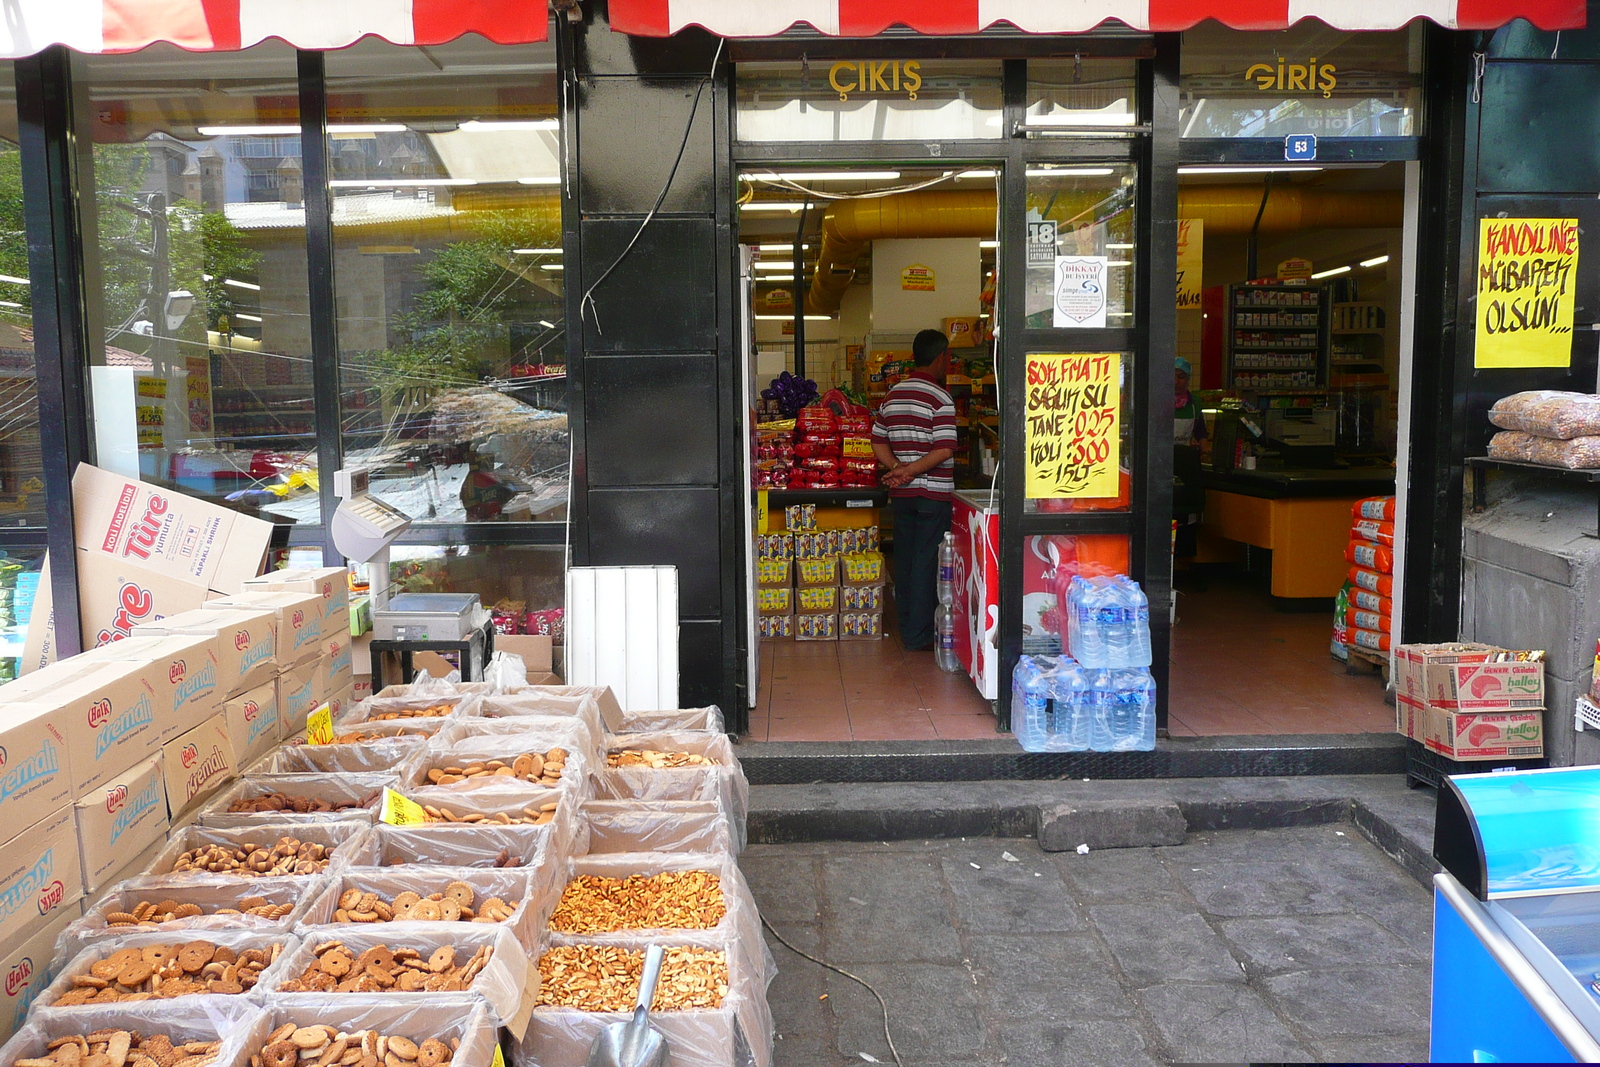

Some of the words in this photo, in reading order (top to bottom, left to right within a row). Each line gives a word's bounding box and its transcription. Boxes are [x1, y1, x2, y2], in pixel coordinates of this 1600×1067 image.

[829, 60, 922, 101] ÇIKIŞ
[1245, 57, 1337, 98] GİRİŞ
[1294, 141, 1307, 153] 53
[1029, 224, 1054, 243] 18
[1480, 257, 1572, 295] MÜBAREK
[1081, 384, 1108, 409] SU
[106, 526, 119, 550] KOLİ
[113, 487, 134, 530] İADELİDİR
[122, 494, 168, 560] Türe
[154, 513, 174, 554] yumurta
[43, 640, 51, 653] 300
[235, 630, 250, 651] Halk
[171, 661, 186, 680] Halk
[1484, 666, 1509, 674] ÜLKER
[1508, 676, 1540, 691] halley
[174, 660, 216, 711] Kremalı
[90, 700, 110, 724] Halk
[96, 693, 153, 760] Kremalı
[1506, 724, 1540, 739] halley
[182, 746, 197, 765] Halk
[0, 739, 58, 803] remalı
[186, 745, 228, 802] Kremalı
[108, 788, 127, 809] Halk
[111, 774, 160, 846] Kremalı
[40, 885, 64, 913] Halk
[8, 962, 32, 992] Halk
